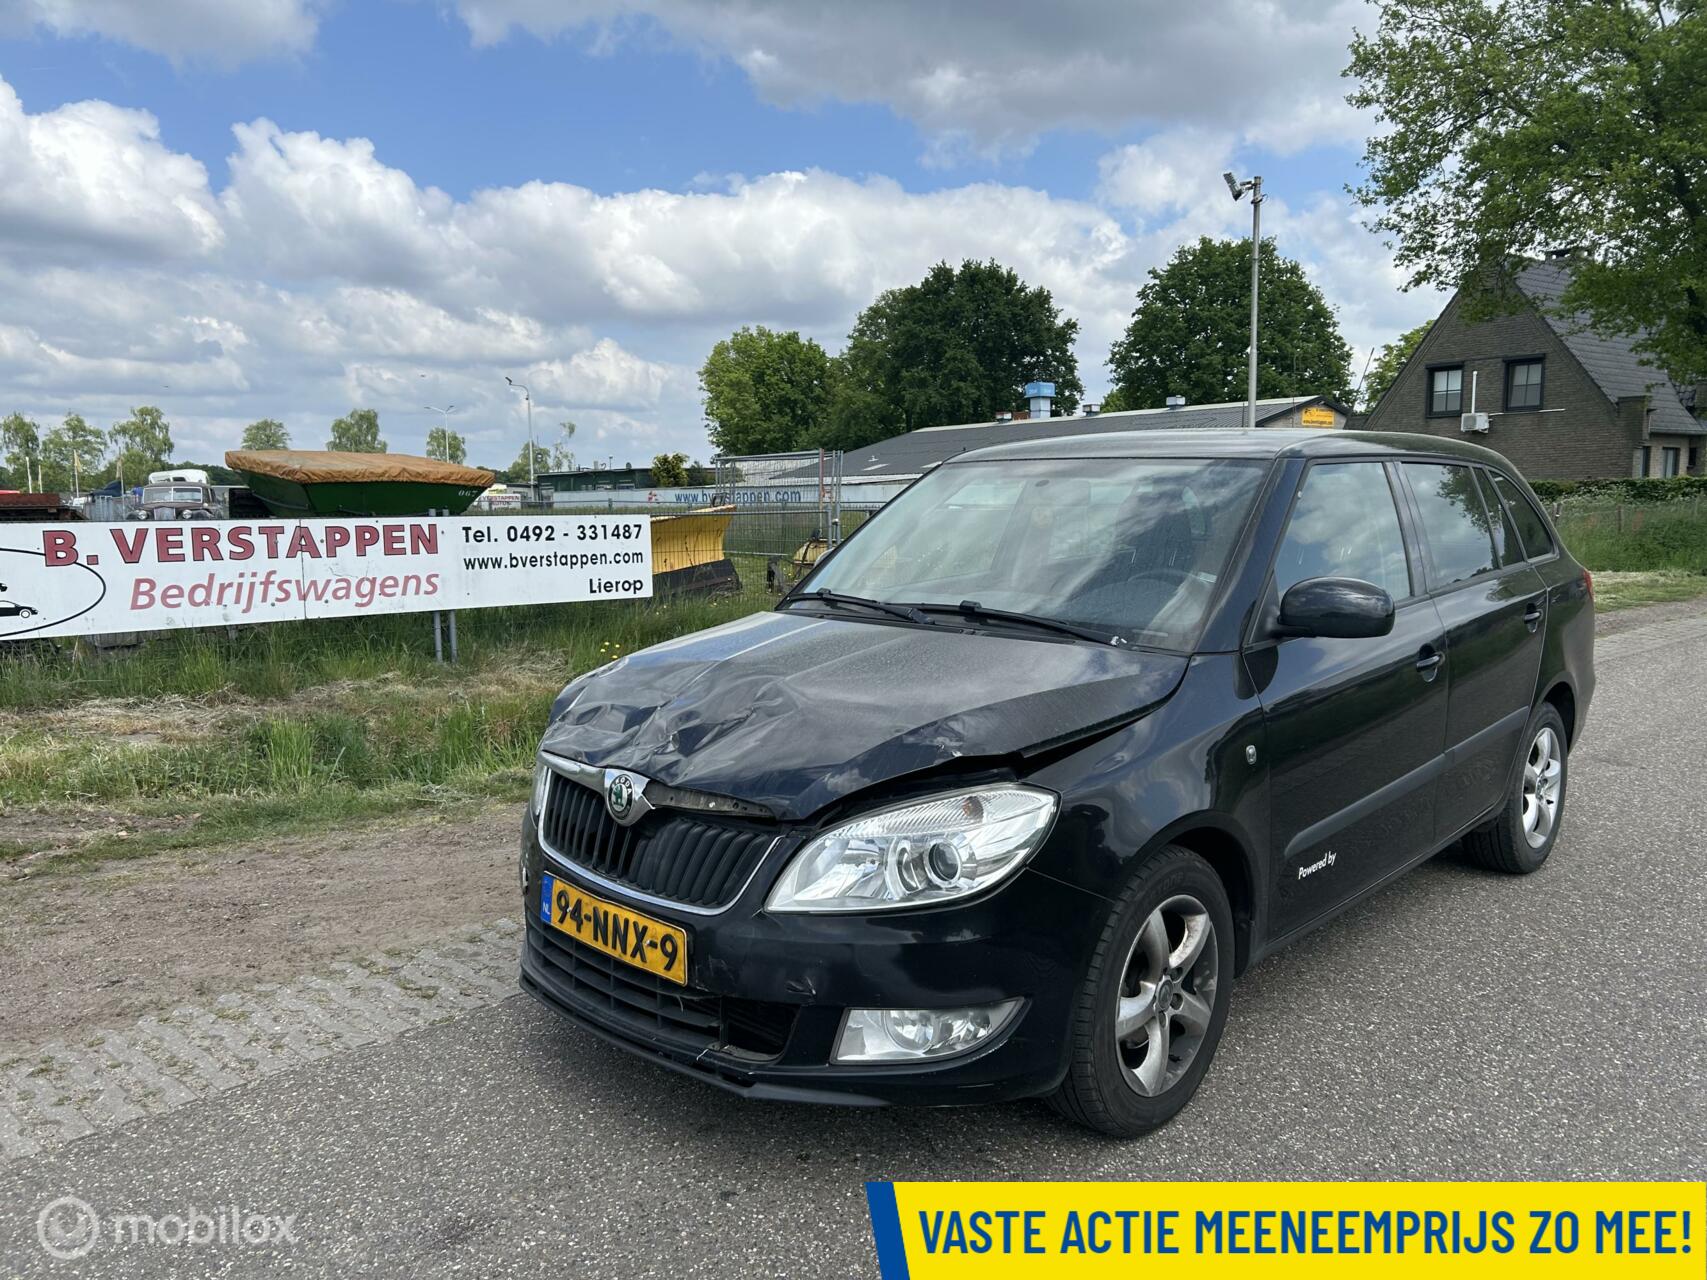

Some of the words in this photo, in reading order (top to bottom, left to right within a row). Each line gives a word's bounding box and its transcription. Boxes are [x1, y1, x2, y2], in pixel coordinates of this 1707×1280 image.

[674, 489, 802, 506] www.bvstappen.com
[462, 526, 498, 543] Tel.
[506, 525, 556, 542] 0492
[577, 524, 643, 541] 331487
[42, 529, 99, 567] B.
[109, 523, 439, 564] VERSTAPPEN
[463, 551, 644, 570] www.bverstappen.com
[129, 570, 440, 614] Bedrijfswagens
[589, 578, 644, 595] Lierop
[1298, 853, 1328, 880] Powered
[1327, 851, 1337, 866] by
[542, 901, 551, 916] NL
[556, 889, 678, 972] 94-NNX-9
